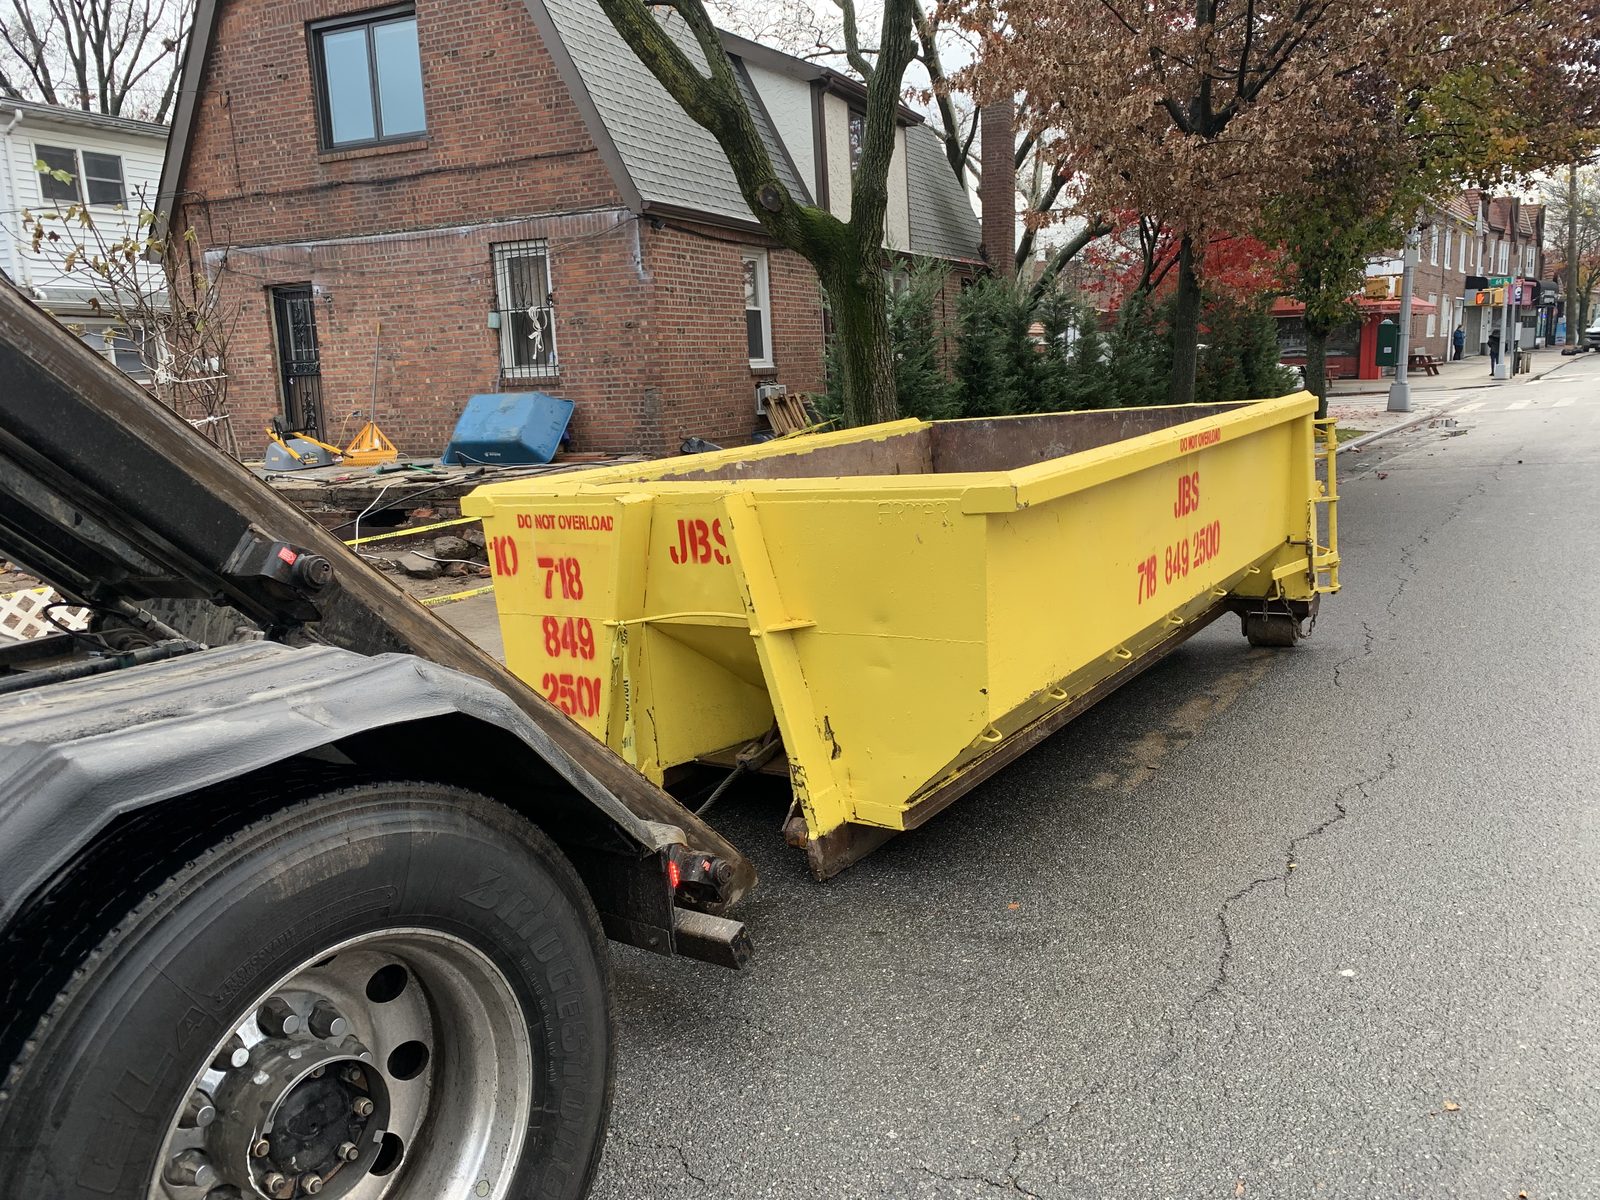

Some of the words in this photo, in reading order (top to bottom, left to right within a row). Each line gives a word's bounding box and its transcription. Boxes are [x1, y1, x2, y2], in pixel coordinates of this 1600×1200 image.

[1174, 471, 1199, 518] JBS
[517, 514, 532, 528] DO
[535, 514, 555, 529] NOT
[558, 515, 614, 531] OVERLOAD
[669, 518, 731, 565] JBS
[489, 535, 518, 576] 10
[1138, 553, 1156, 605] 718
[1165, 538, 1189, 585] 849
[1193, 519, 1220, 569] 2500
[538, 557, 583, 600] 718
[543, 616, 595, 660] 849
